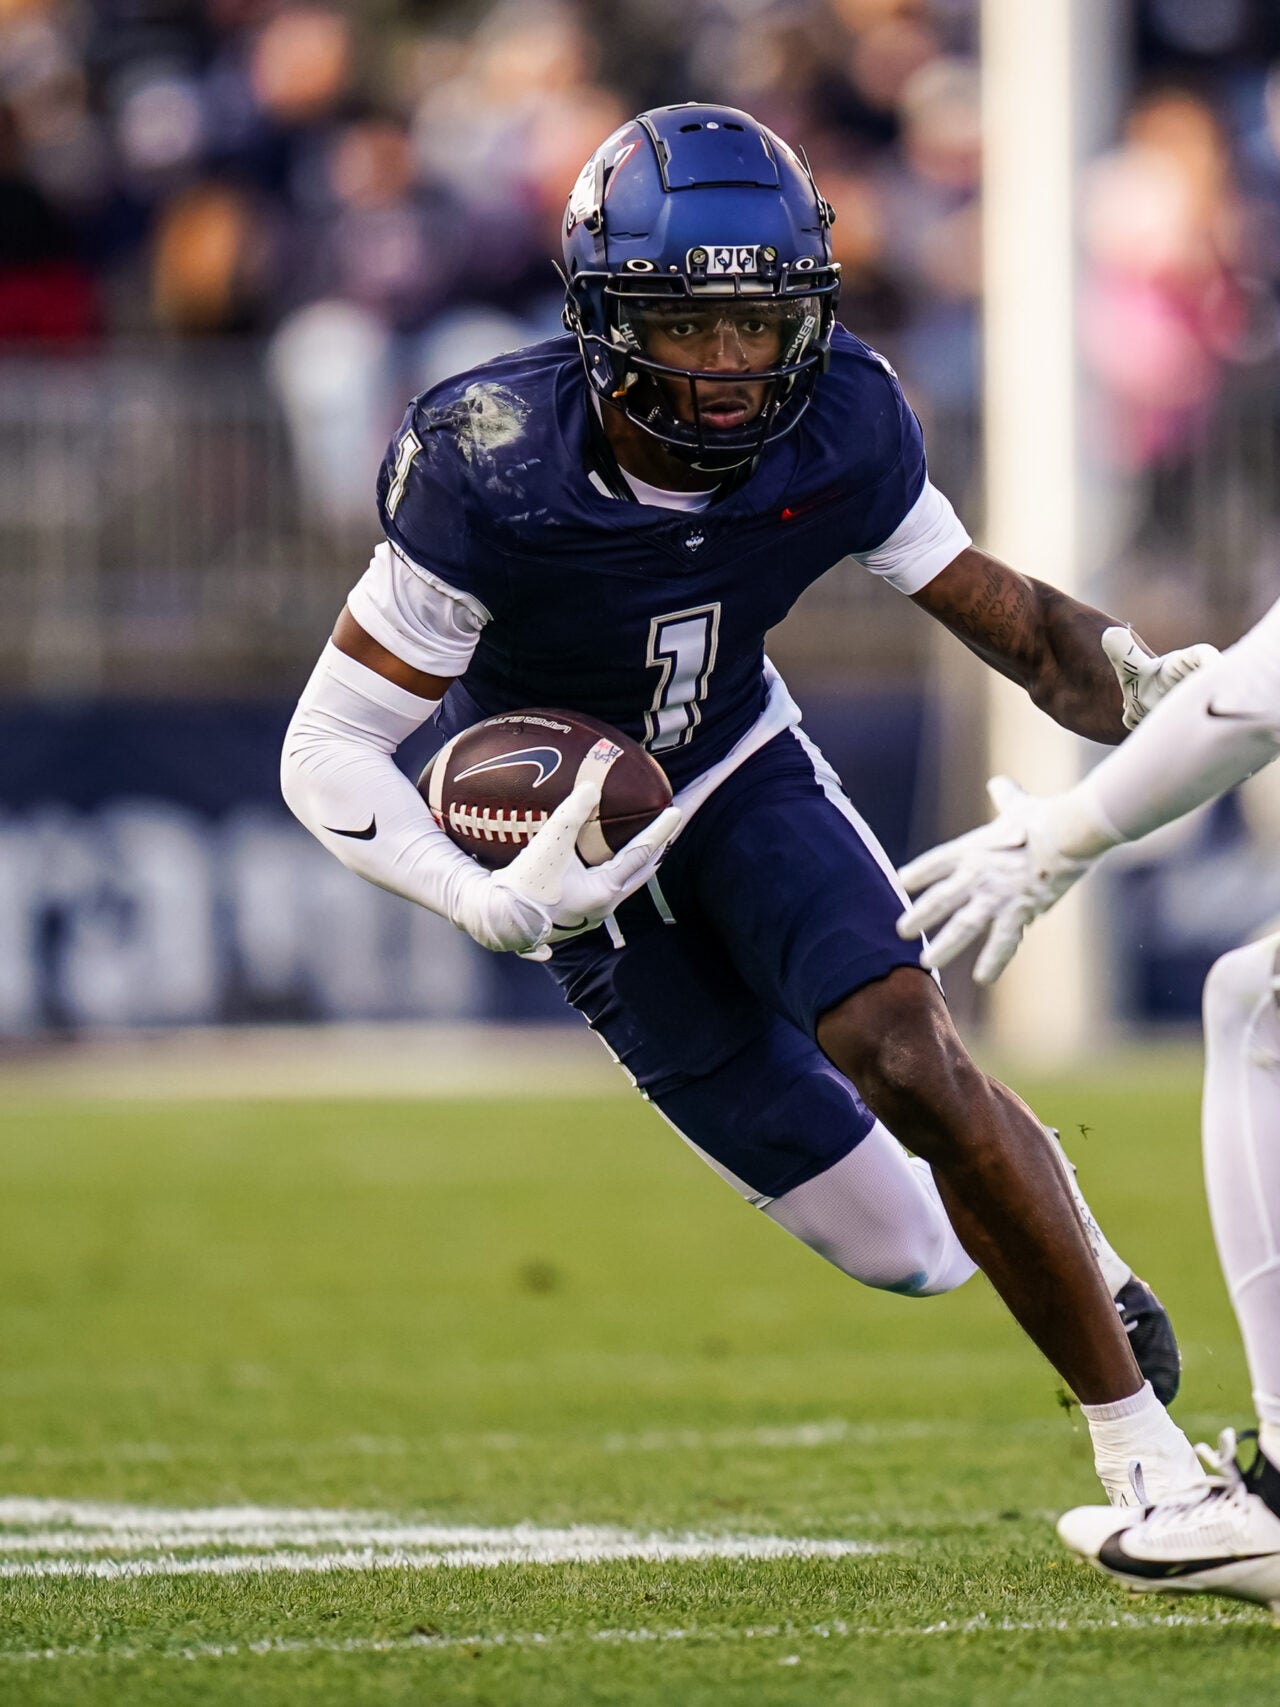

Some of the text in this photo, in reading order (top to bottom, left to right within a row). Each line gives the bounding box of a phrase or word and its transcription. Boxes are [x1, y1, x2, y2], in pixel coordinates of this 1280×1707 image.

[781, 314, 817, 370] USKIES
[384, 426, 424, 521] 1
[638, 601, 722, 757] 1
